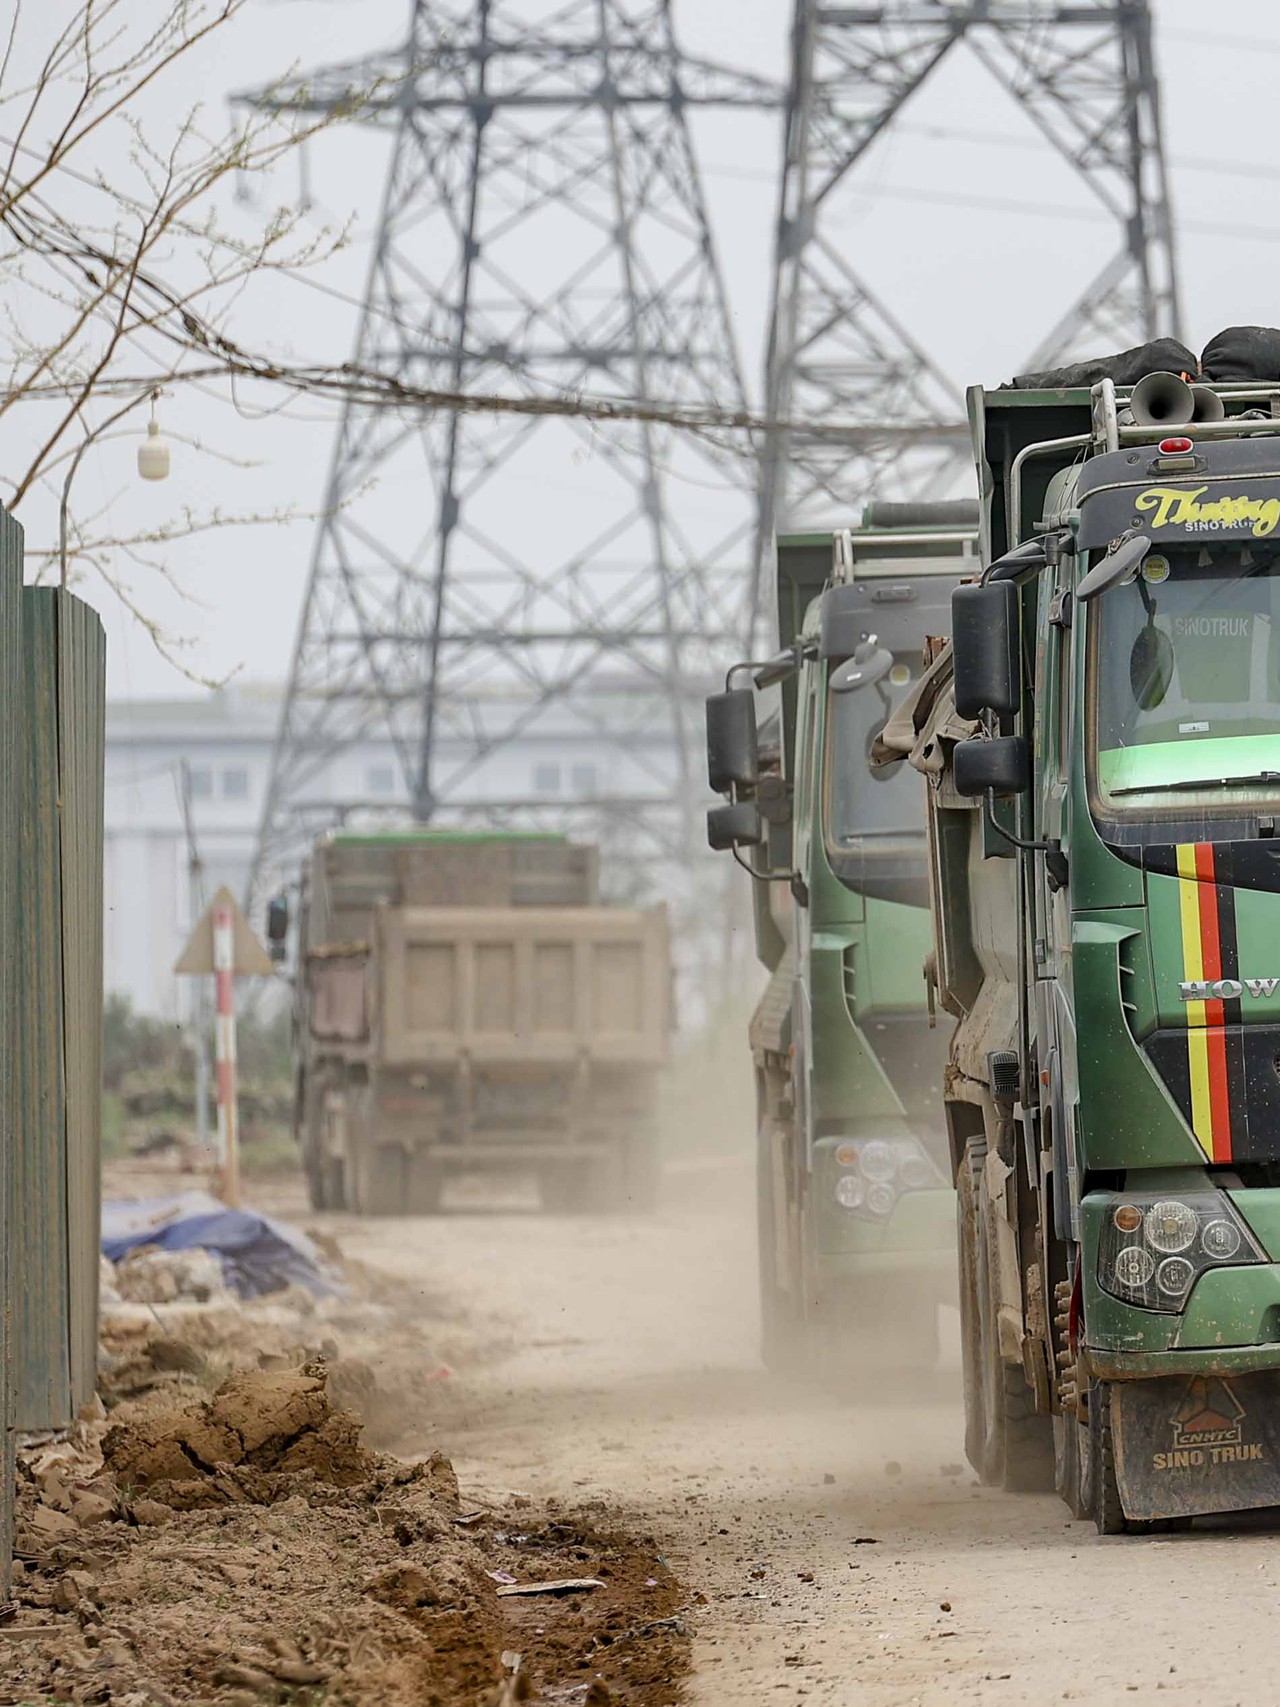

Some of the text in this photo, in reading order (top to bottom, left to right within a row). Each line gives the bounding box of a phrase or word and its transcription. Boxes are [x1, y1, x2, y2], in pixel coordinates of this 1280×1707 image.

[1175, 616, 1249, 637] SINOTRUK
[1179, 1429, 1238, 1444] CNHTC
[1153, 1443, 1264, 1470] SINO TRUK
